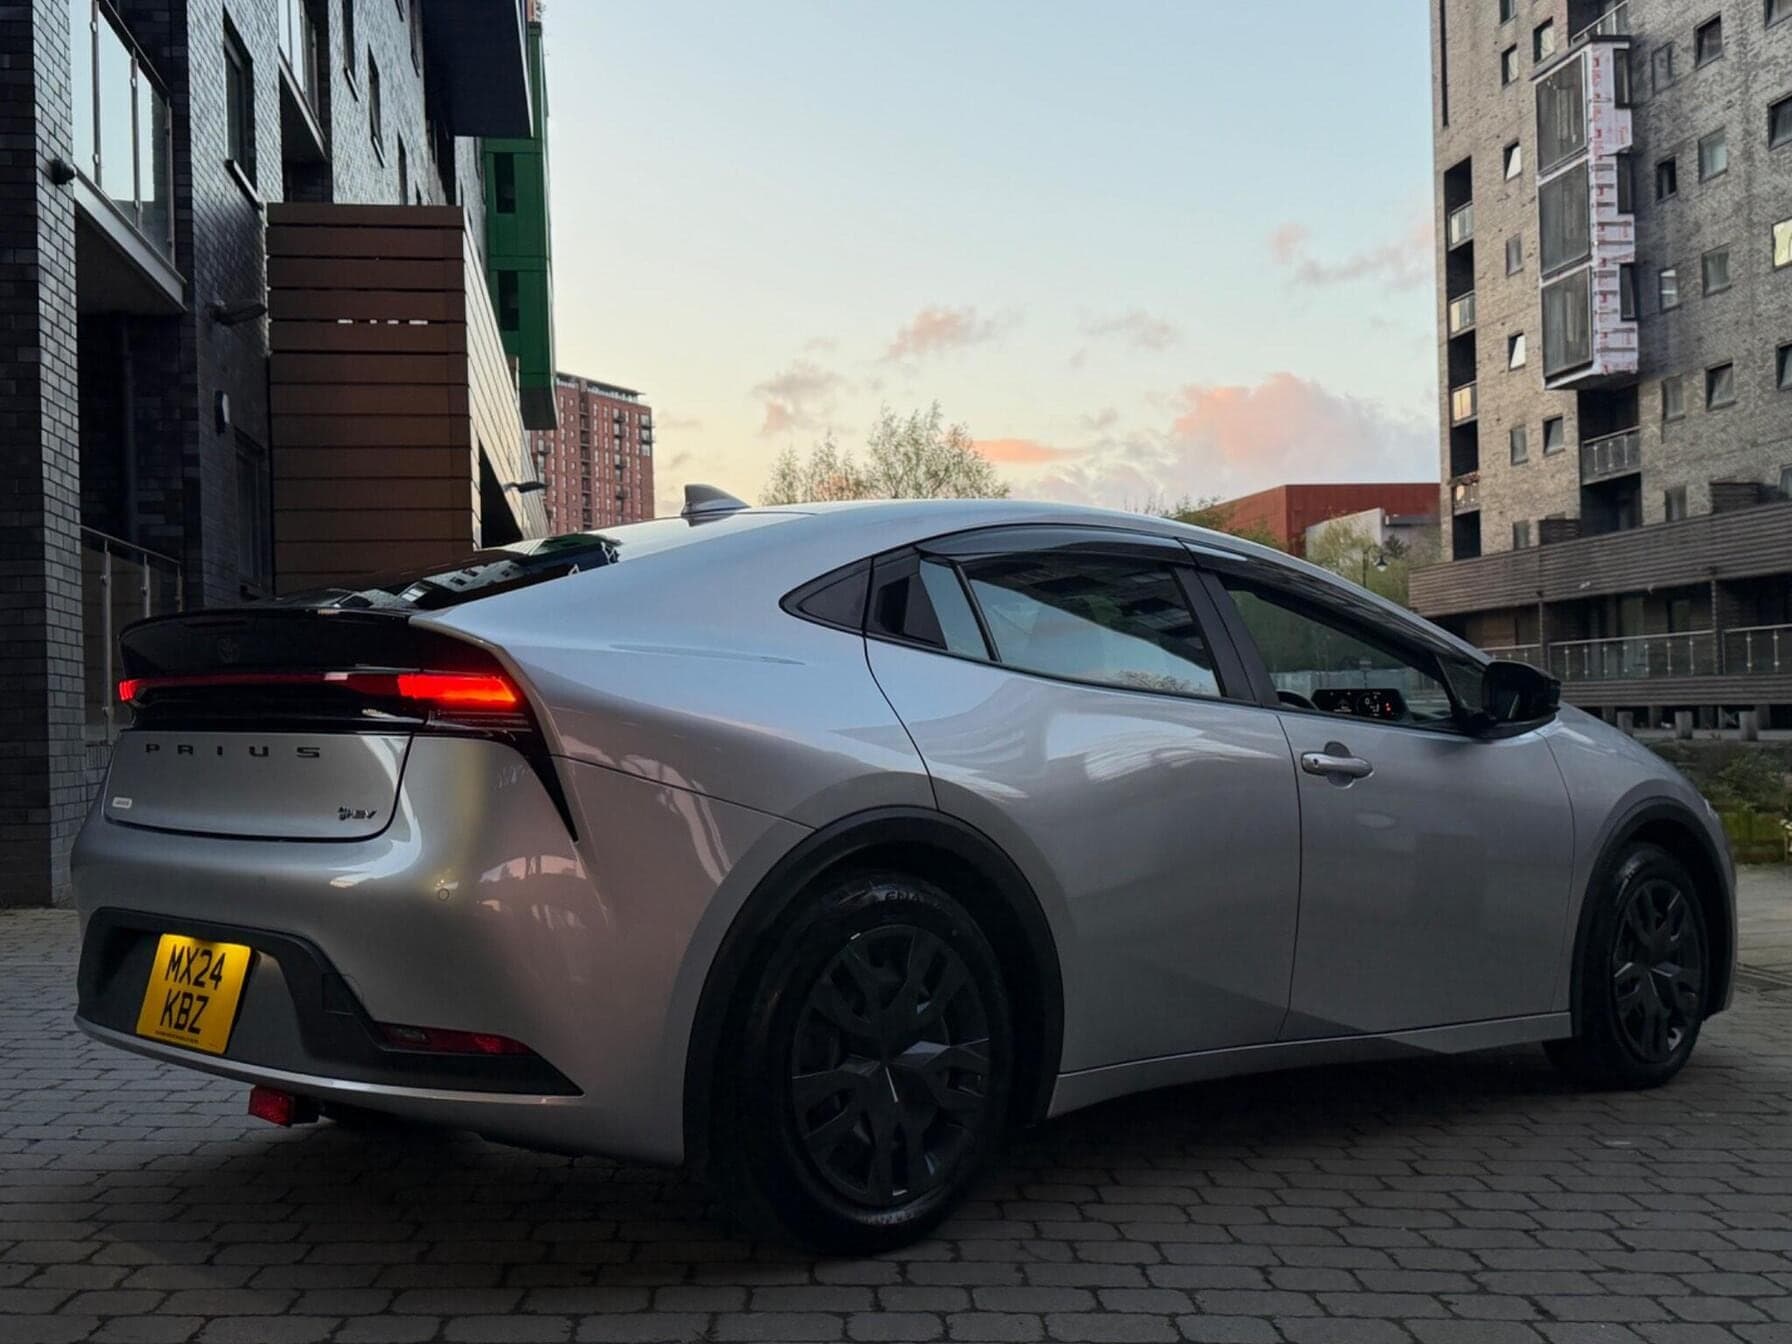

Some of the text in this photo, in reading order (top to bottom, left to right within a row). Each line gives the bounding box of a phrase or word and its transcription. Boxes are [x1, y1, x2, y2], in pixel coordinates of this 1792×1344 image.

[145, 743, 321, 758] PRIUS
[165, 944, 226, 991] MX24
[160, 988, 209, 1035] KBZ
